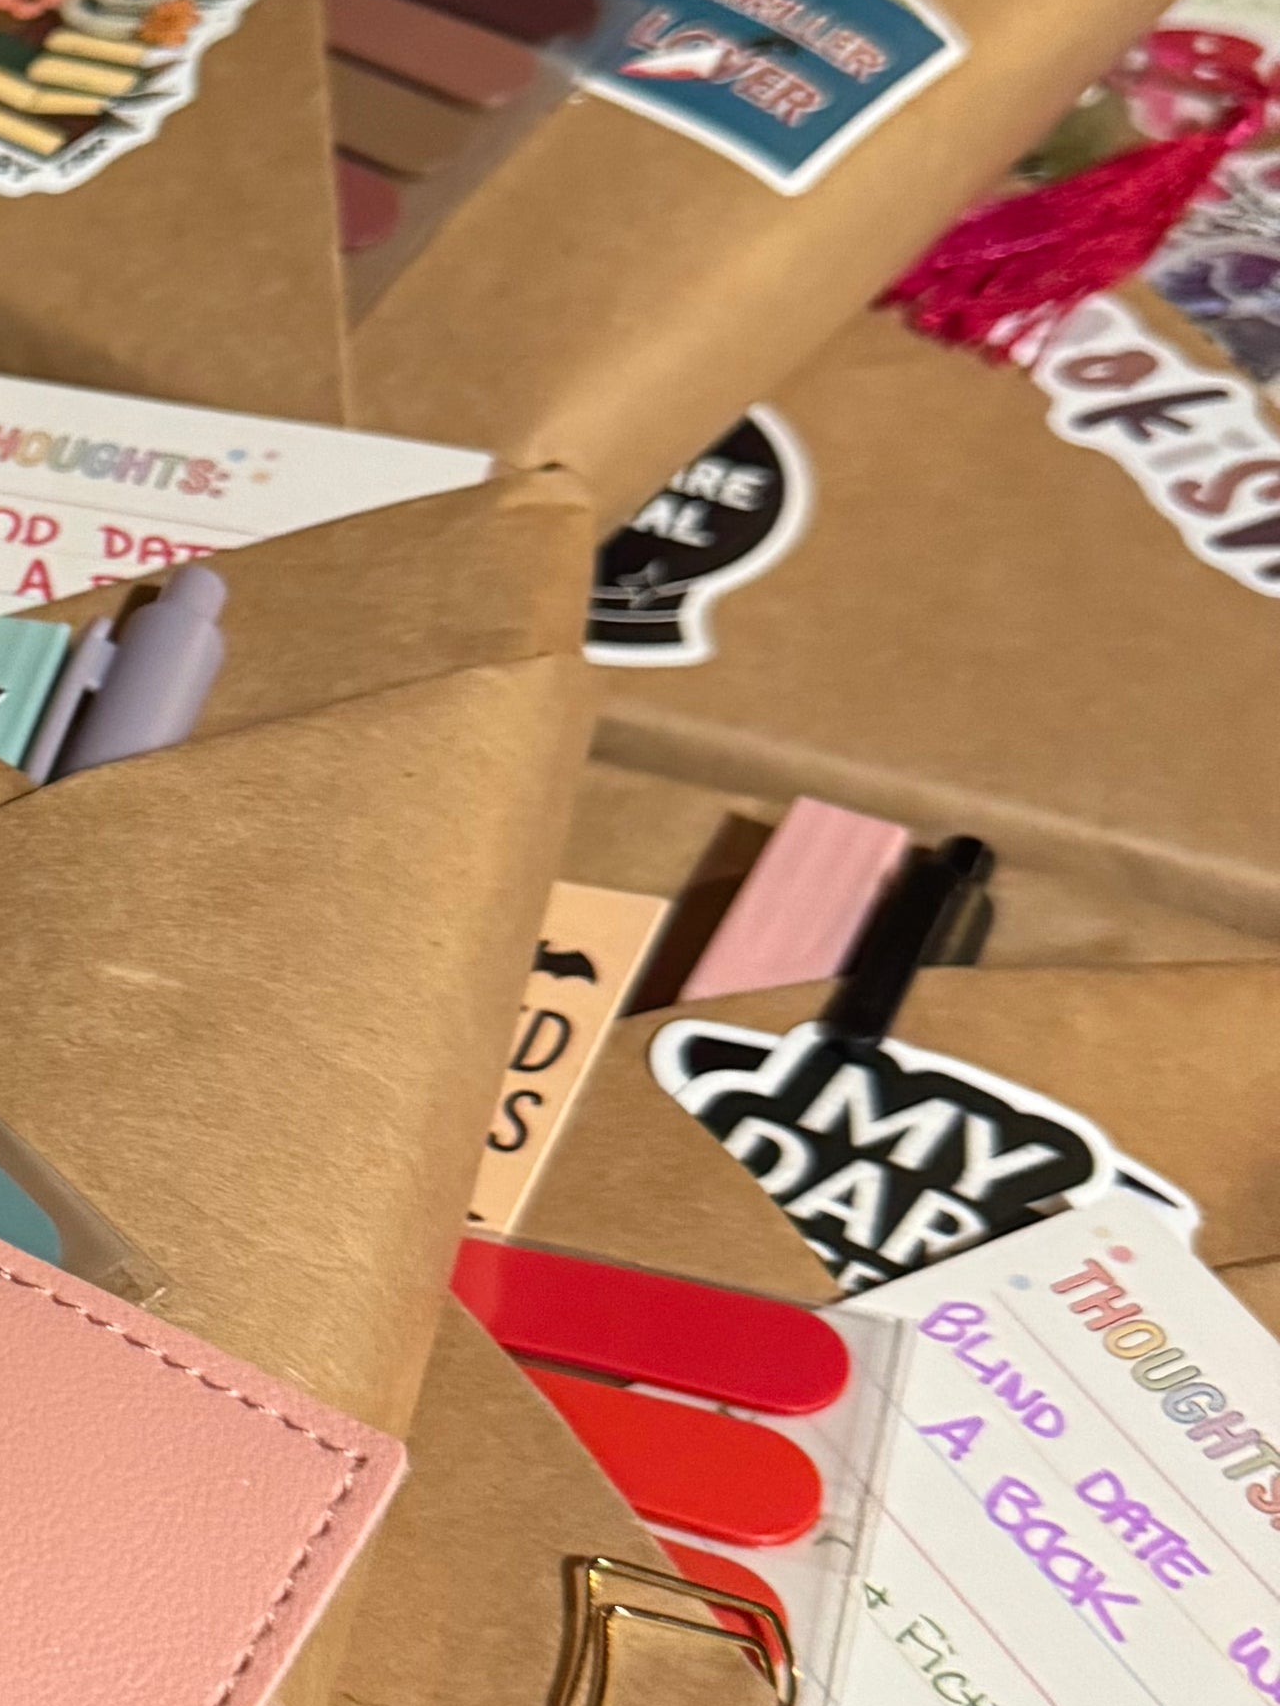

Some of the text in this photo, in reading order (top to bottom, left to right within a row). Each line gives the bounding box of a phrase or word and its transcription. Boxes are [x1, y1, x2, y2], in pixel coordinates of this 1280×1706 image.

[624, 4, 833, 129] LOVER
[15, 558, 54, 603] A
[797, 1062, 1062, 1200] MY
[917, 1300, 1066, 1439] BLIND
[1074, 1467, 1213, 1590] DATE
[915, 1415, 1142, 1645] A BOOK
